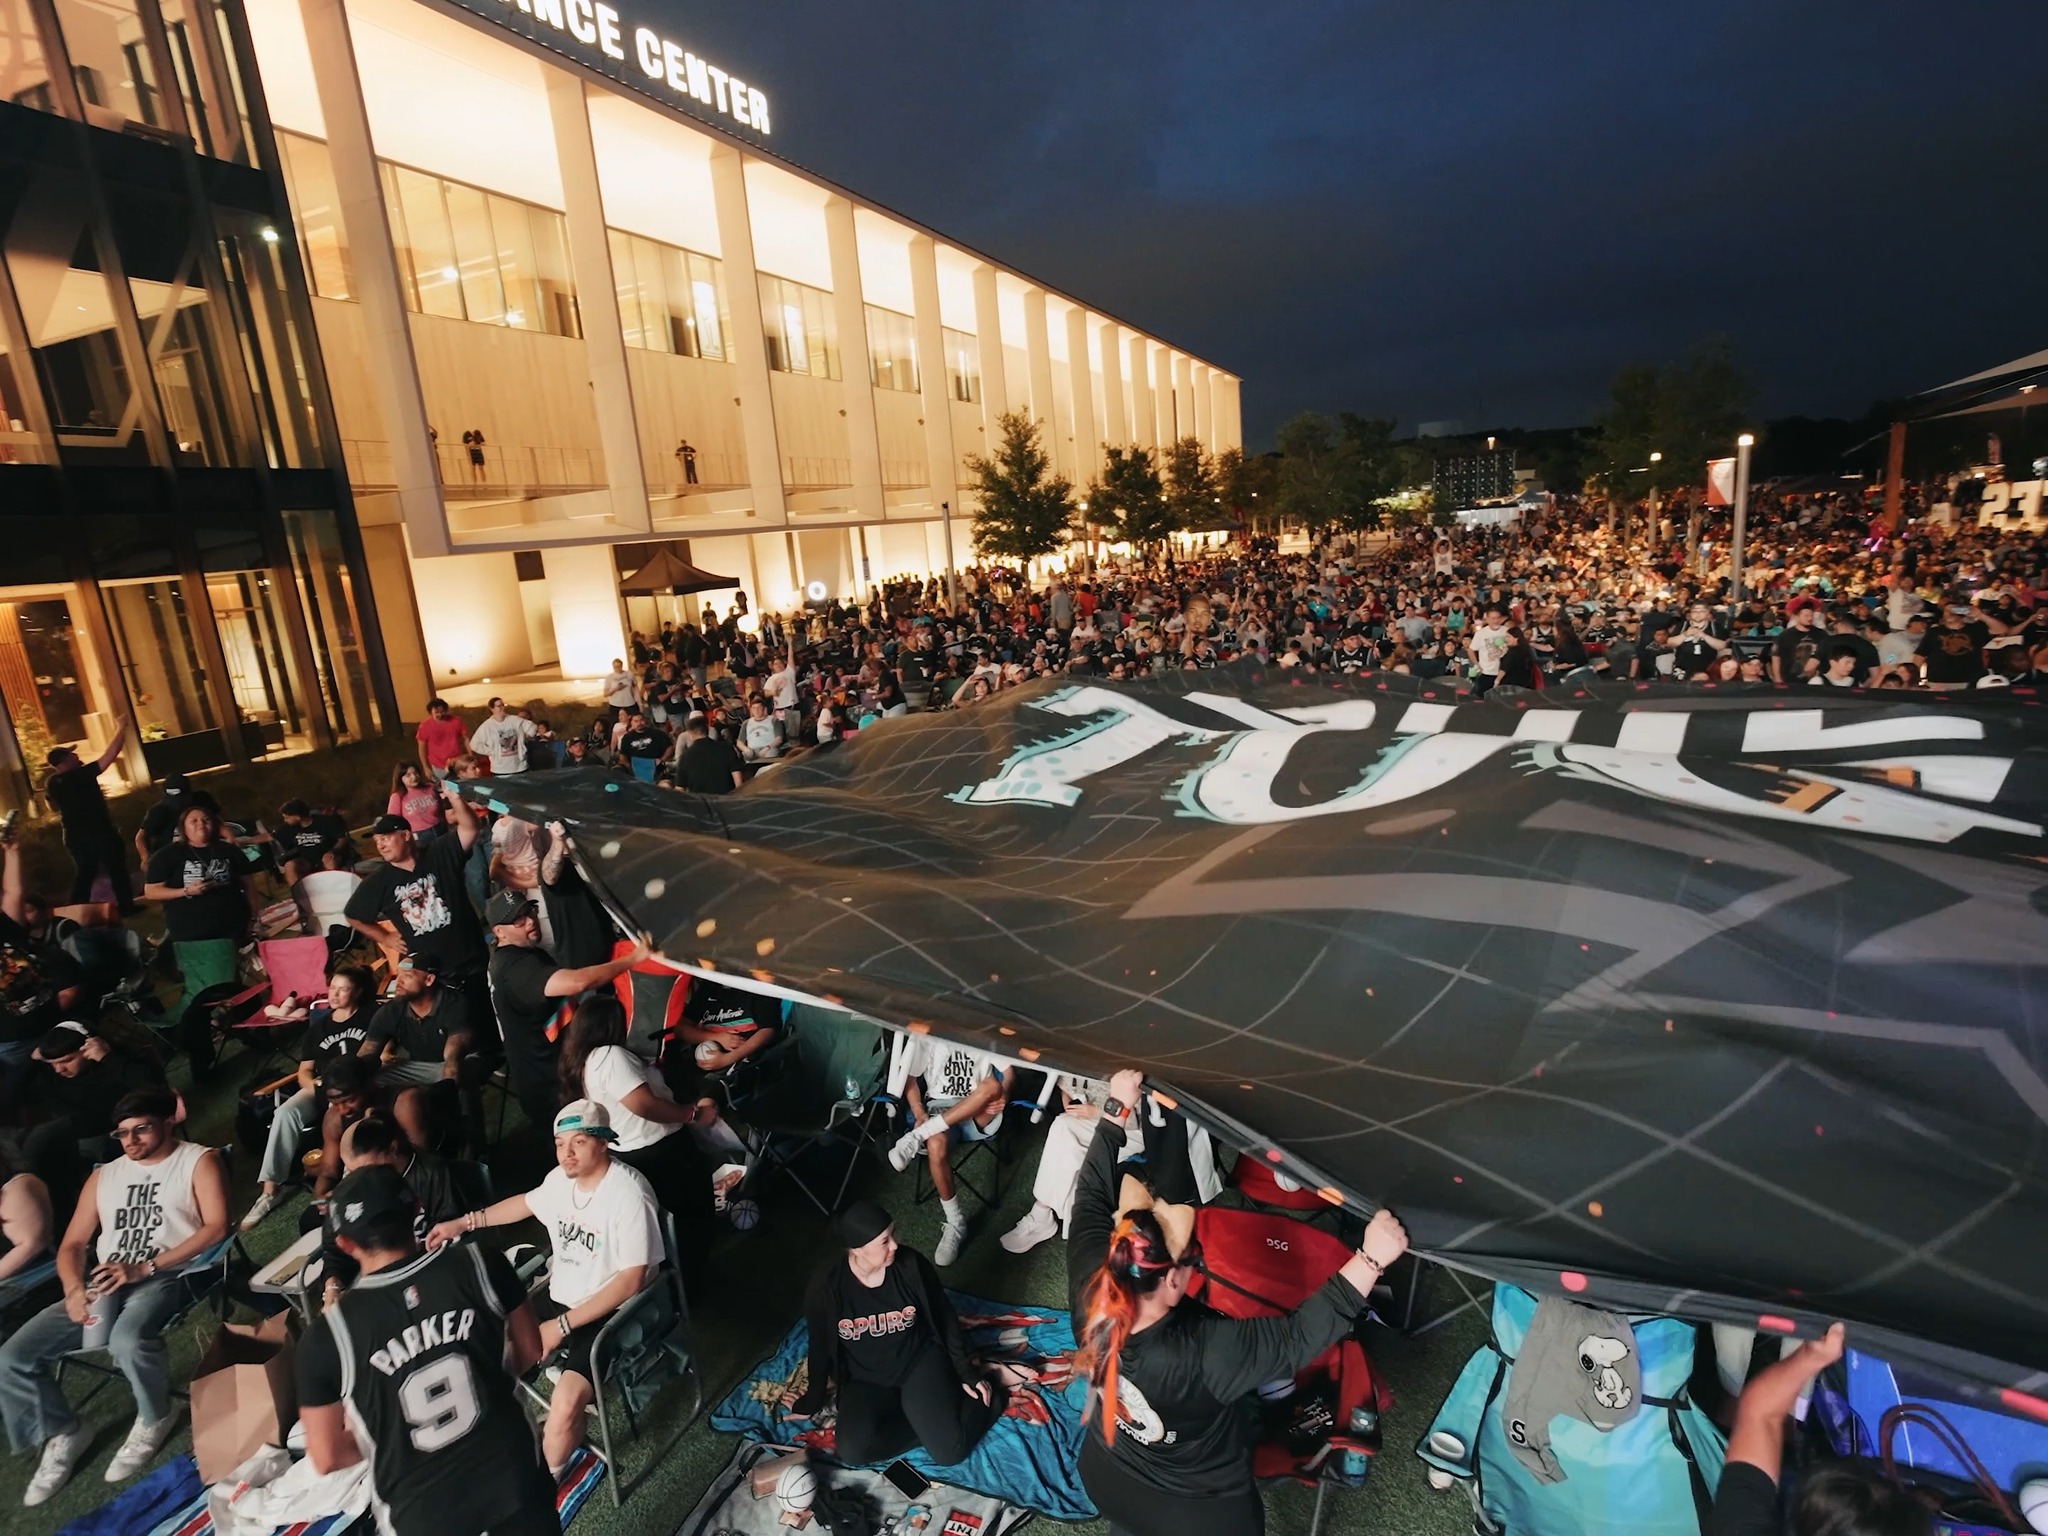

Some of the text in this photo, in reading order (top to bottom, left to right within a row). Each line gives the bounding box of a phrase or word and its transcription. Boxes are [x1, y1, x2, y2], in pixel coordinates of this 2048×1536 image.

[635, 27, 771, 135] CENTER
[338, 1040, 347, 1055] 1
[126, 1182, 161, 1207] THE
[115, 1205, 163, 1230] BOYS
[117, 1227, 156, 1251] ARE
[1266, 1238, 1289, 1252] DSG
[838, 1305, 917, 1341] SPURS
[369, 1308, 475, 1377] PARKER
[398, 1351, 482, 1453] 9
[1509, 1418, 1528, 1446] S
[948, 1522, 974, 1536] TNT
